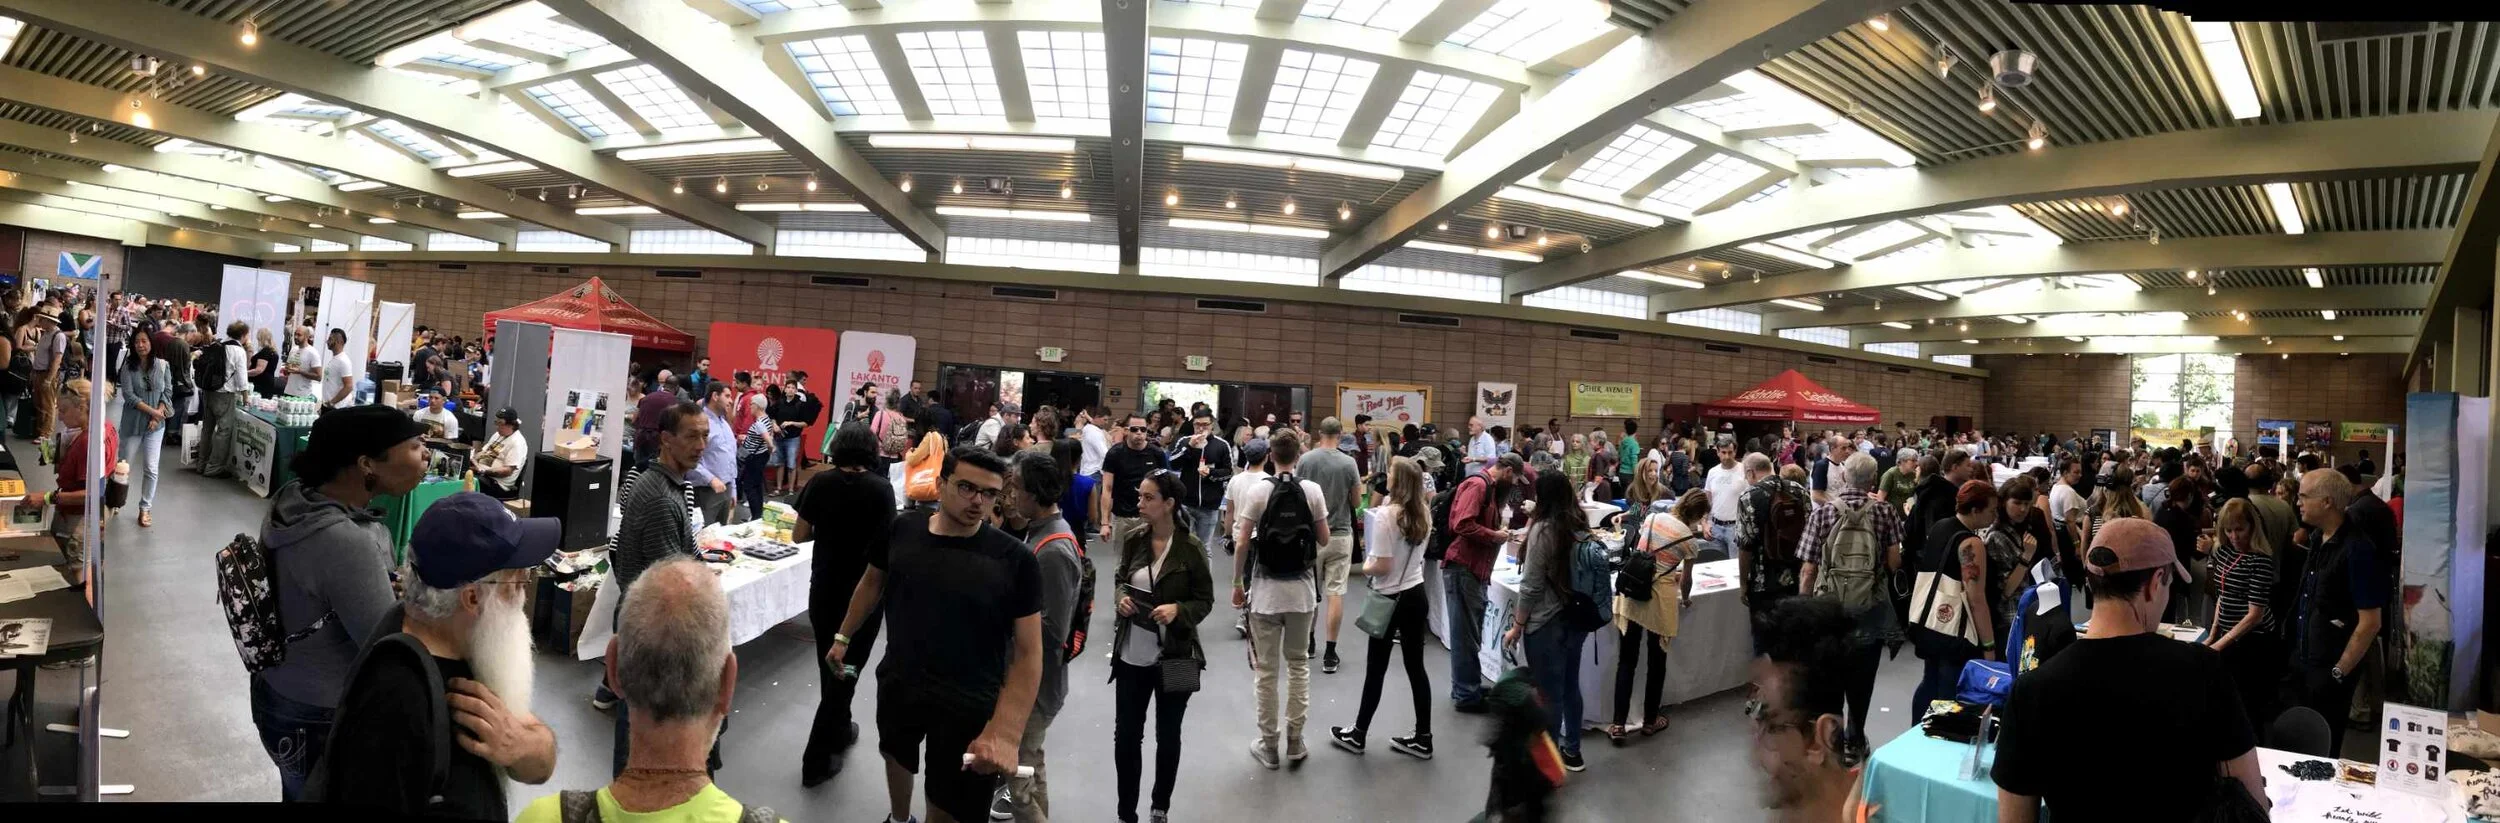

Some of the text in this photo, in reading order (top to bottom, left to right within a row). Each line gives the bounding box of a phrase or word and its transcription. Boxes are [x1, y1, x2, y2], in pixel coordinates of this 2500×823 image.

[851, 372, 899, 384] LAKANTO
[1578, 383, 1633, 394] OTHER AVENUES
[1366, 398, 1383, 412] Red
